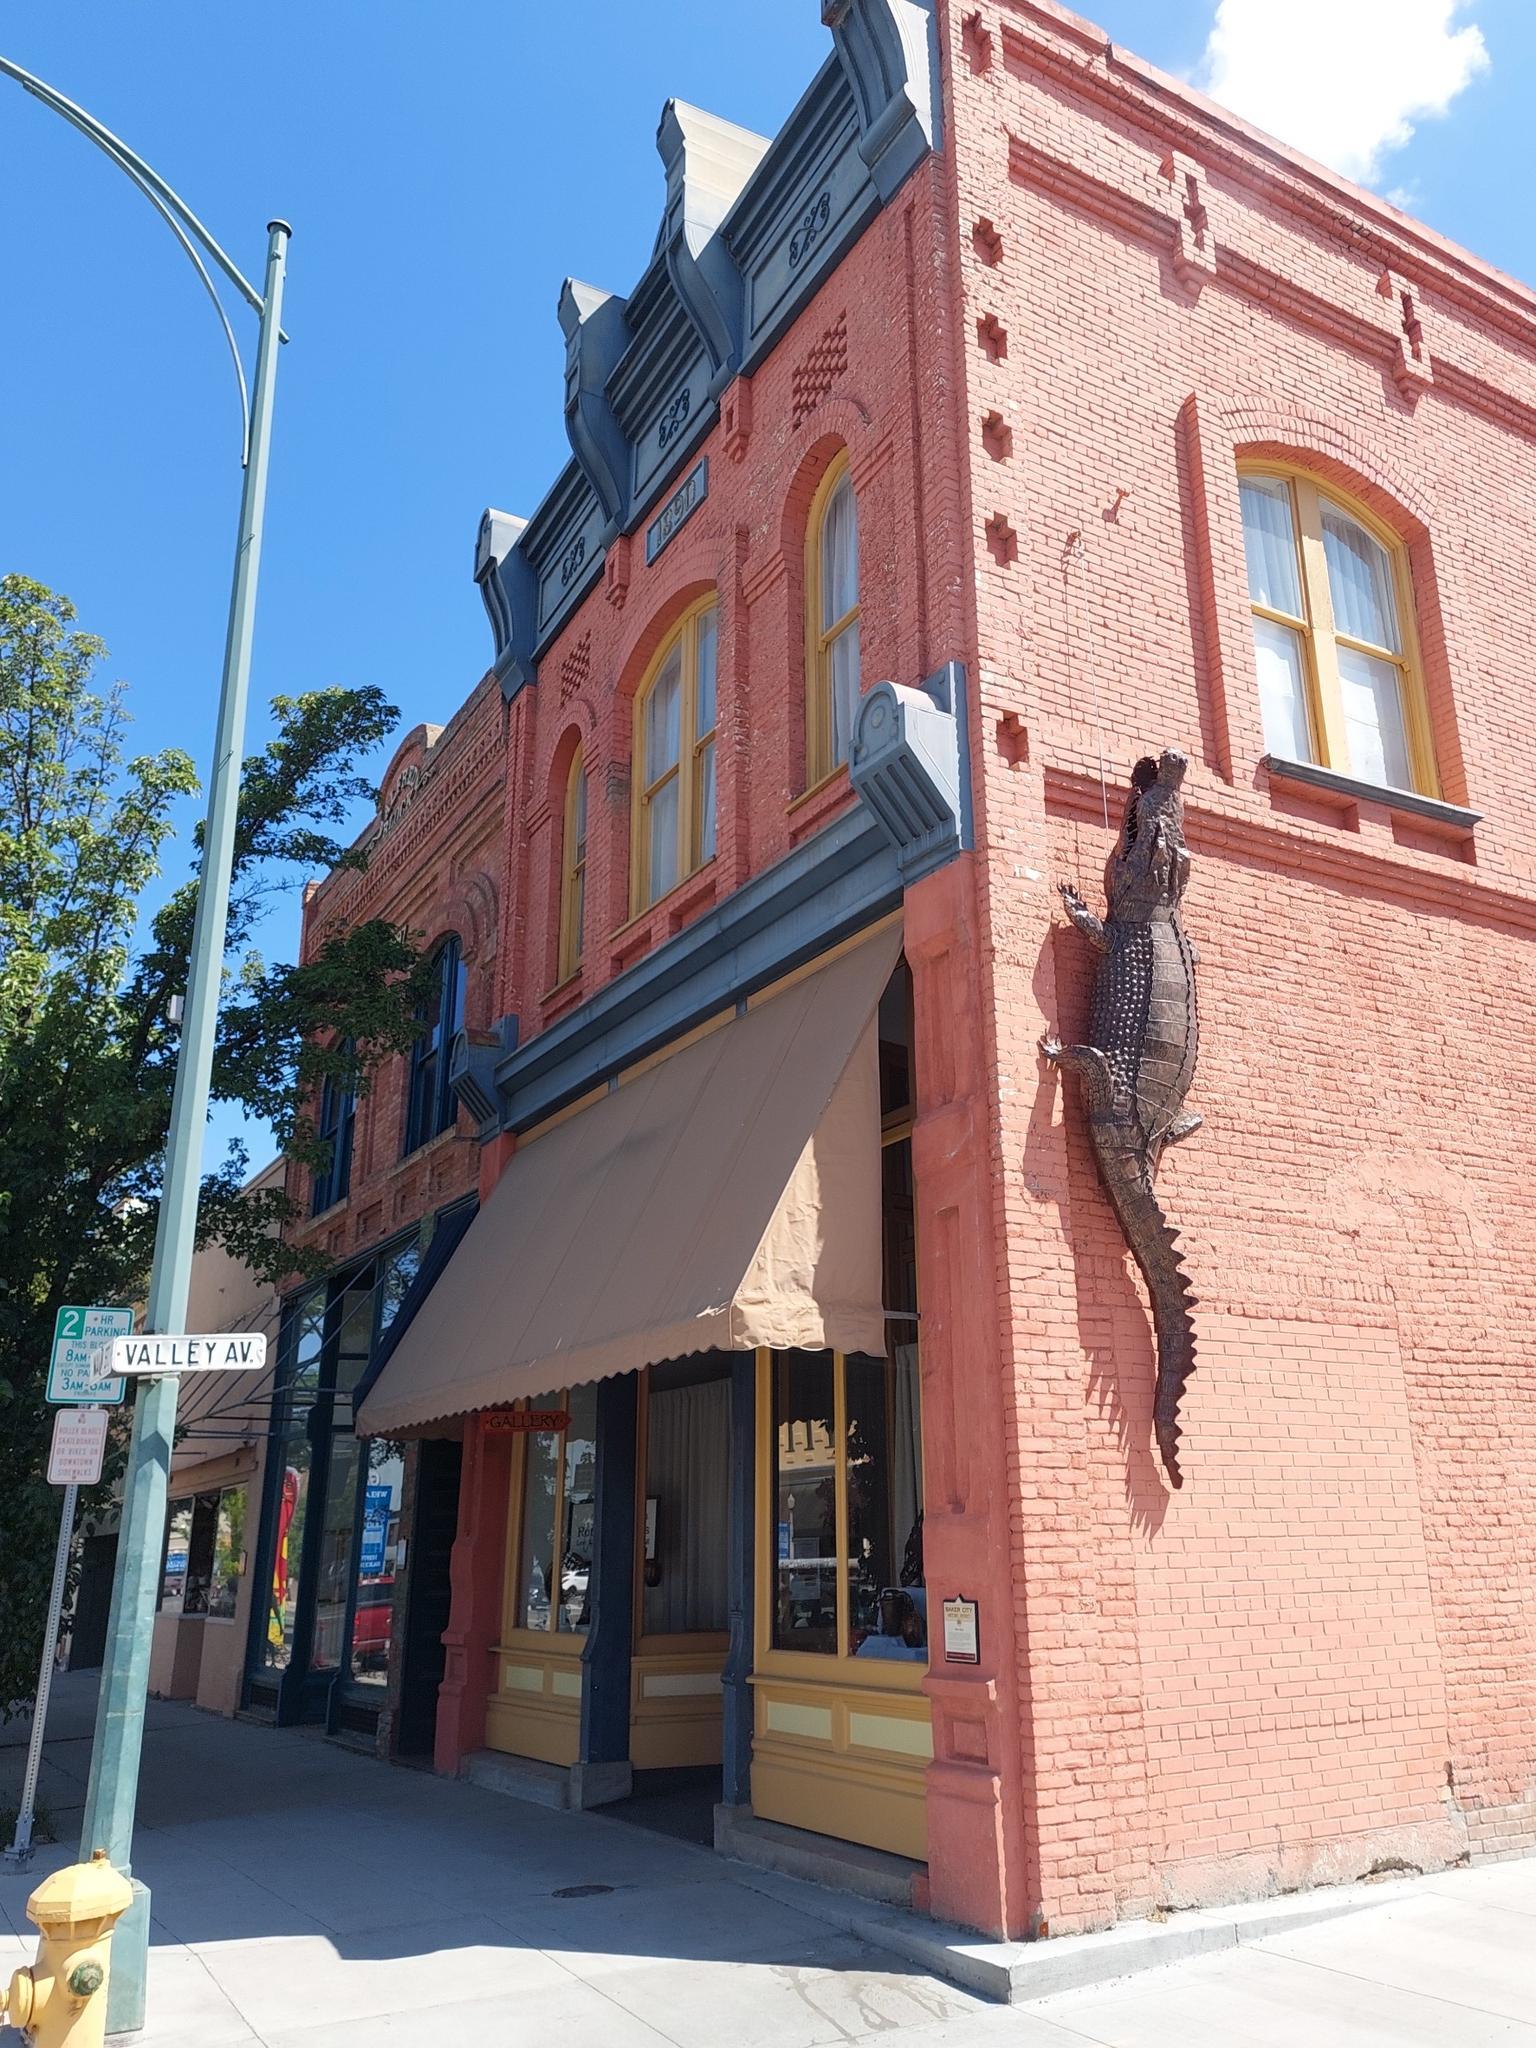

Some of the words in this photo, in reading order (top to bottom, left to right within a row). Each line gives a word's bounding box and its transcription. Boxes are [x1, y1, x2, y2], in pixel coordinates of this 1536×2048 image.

[62, 1310, 79, 1336] 2
[101, 1315, 114, 1324] HR
[85, 1327, 126, 1337] PARKING
[71, 1341, 87, 1349] THIS
[126, 1340, 216, 1366] VALLEY
[225, 1341, 254, 1364] AV.
[61, 1369, 73, 1377] NO
[489, 1414, 560, 1428] GALLERY
